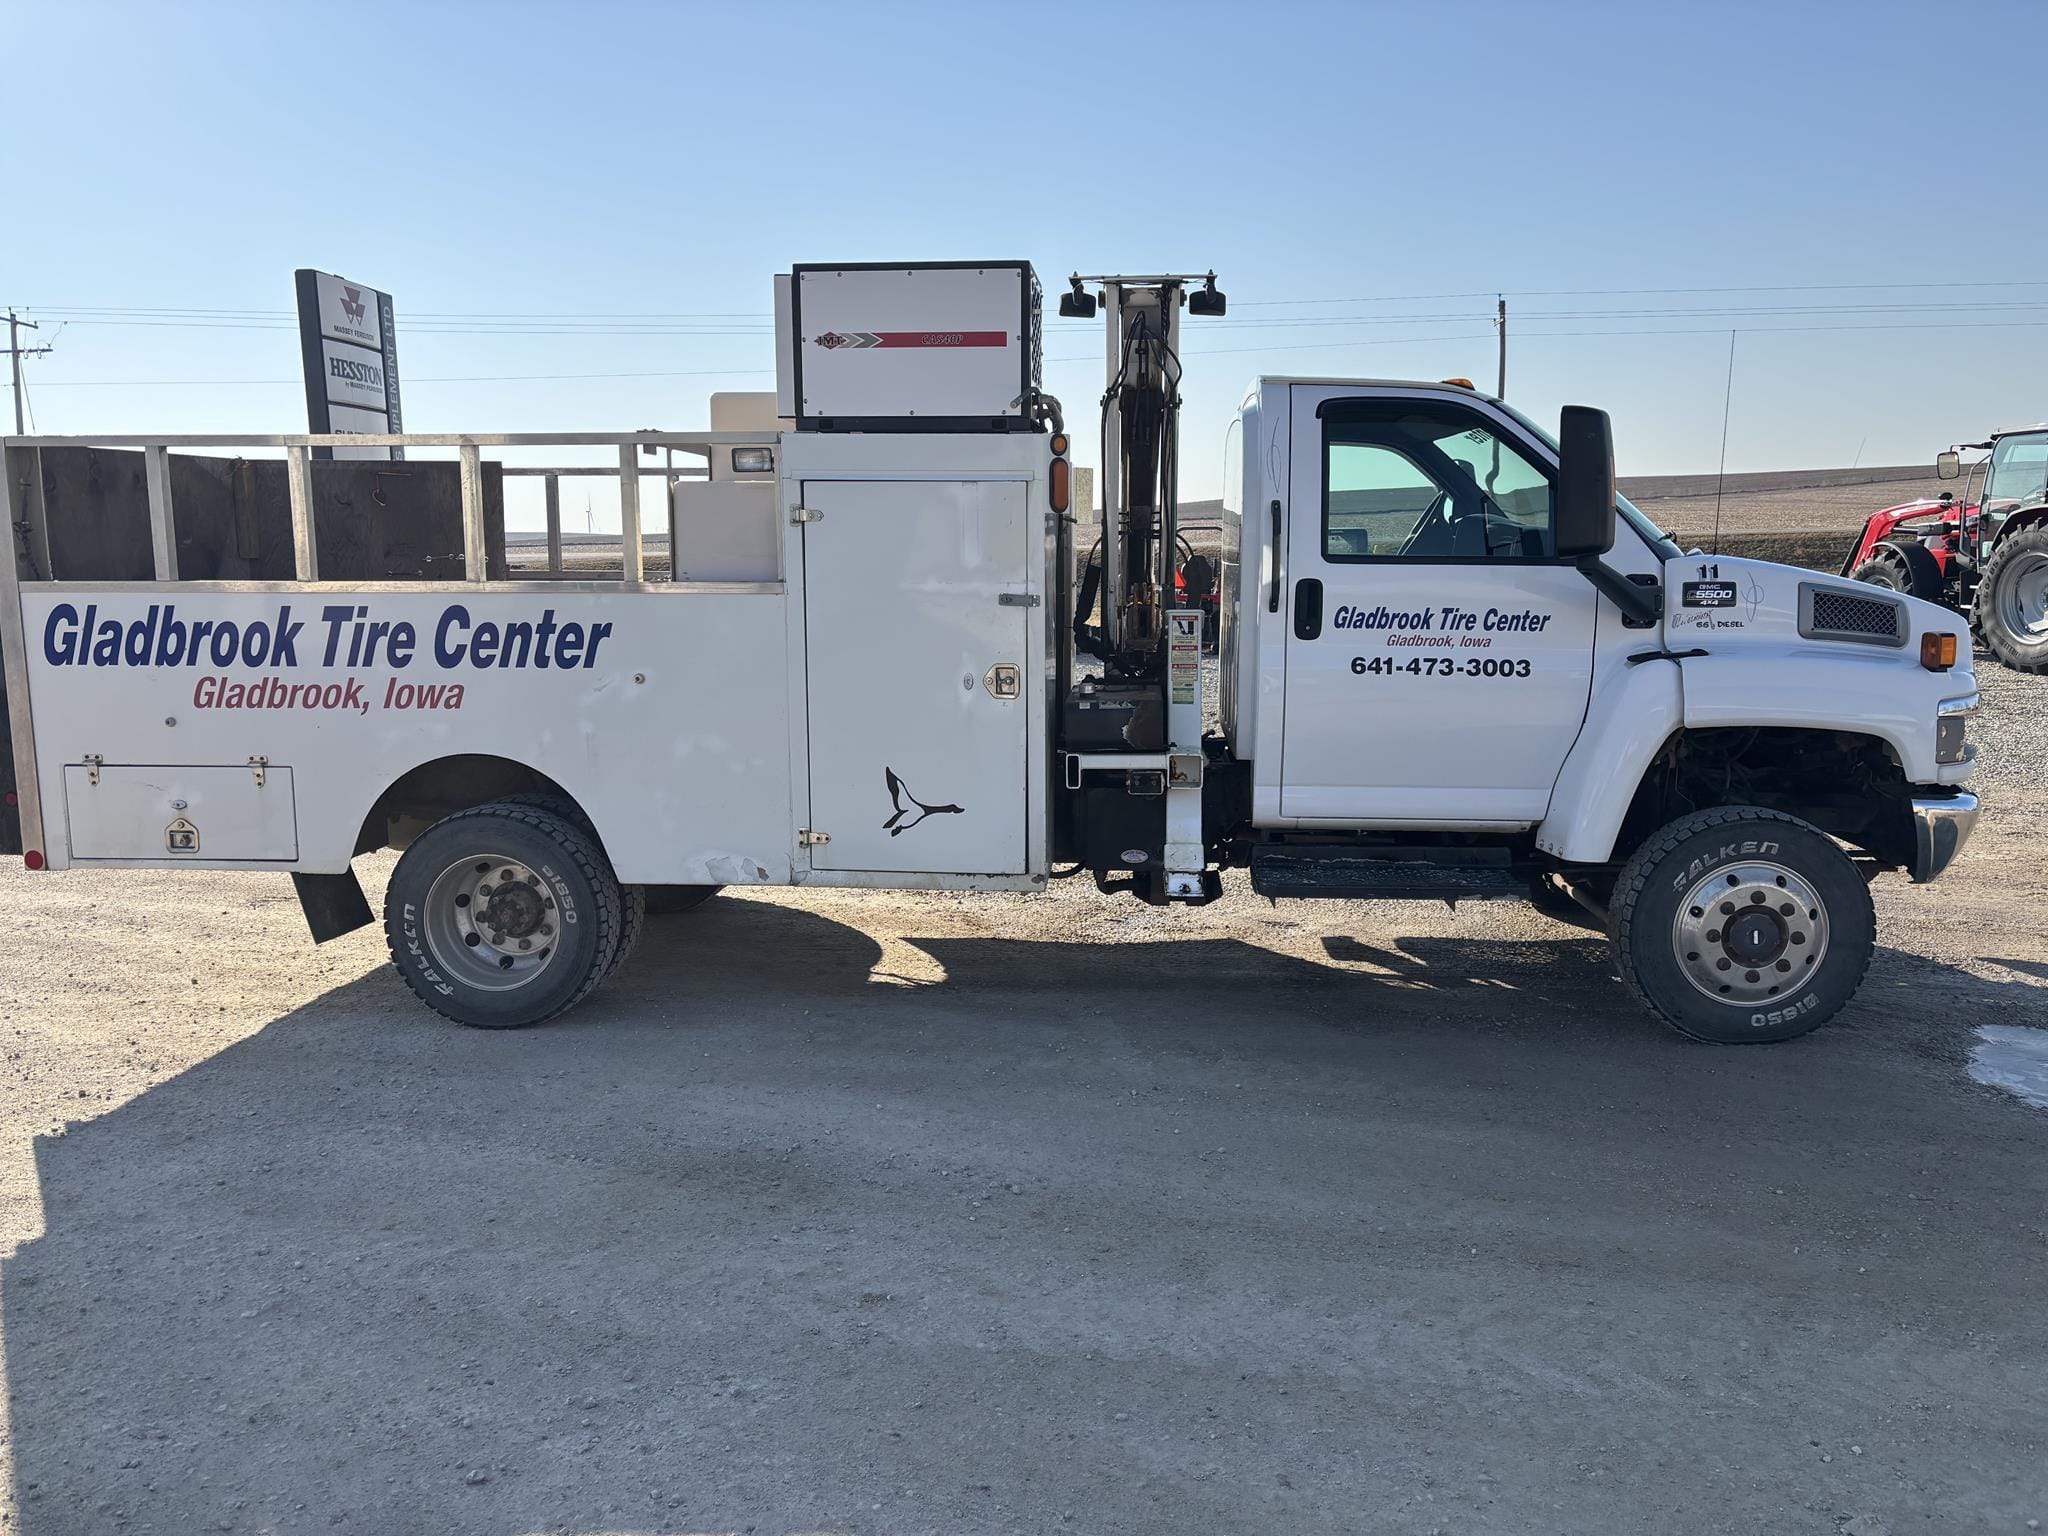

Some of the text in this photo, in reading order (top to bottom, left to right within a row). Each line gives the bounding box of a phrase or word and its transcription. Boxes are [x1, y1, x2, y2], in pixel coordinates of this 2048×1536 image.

[329, 357, 382, 386] HESSTON
[383, 306, 401, 434] MPLEMENT LTD
[1699, 564, 1719, 579] 11
[1333, 605, 1551, 632] Gladbrook Tire Center
[43, 603, 612, 669] Gladbrook Tire Center
[1386, 634, 1492, 650] Gladbrook, Iowa
[1350, 656, 1531, 677] 641-473-3003
[192, 676, 465, 715] Gladbrook, Iowa
